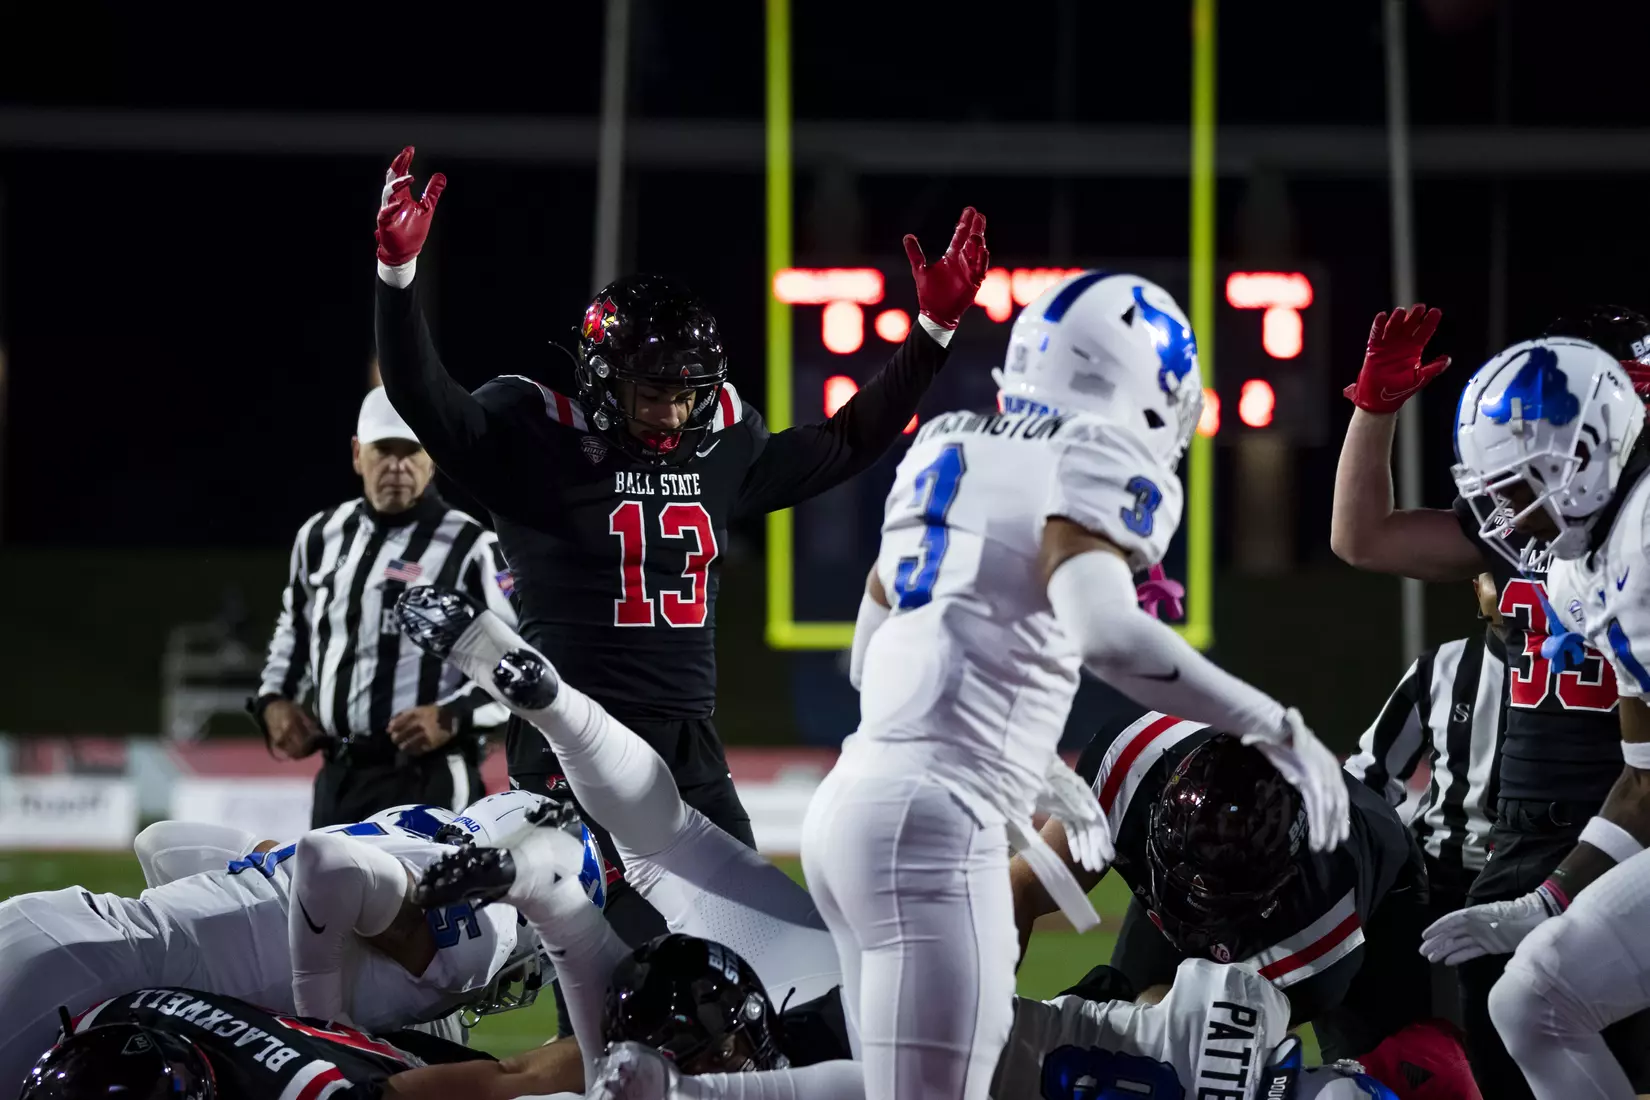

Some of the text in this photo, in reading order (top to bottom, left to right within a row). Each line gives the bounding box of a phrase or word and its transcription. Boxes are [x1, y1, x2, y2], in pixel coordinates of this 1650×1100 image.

[614, 471, 702, 496] BALL STATE
[1120, 476, 1162, 537] 3
[608, 500, 719, 629] 13
[129, 989, 301, 1073] BLACKWELL
